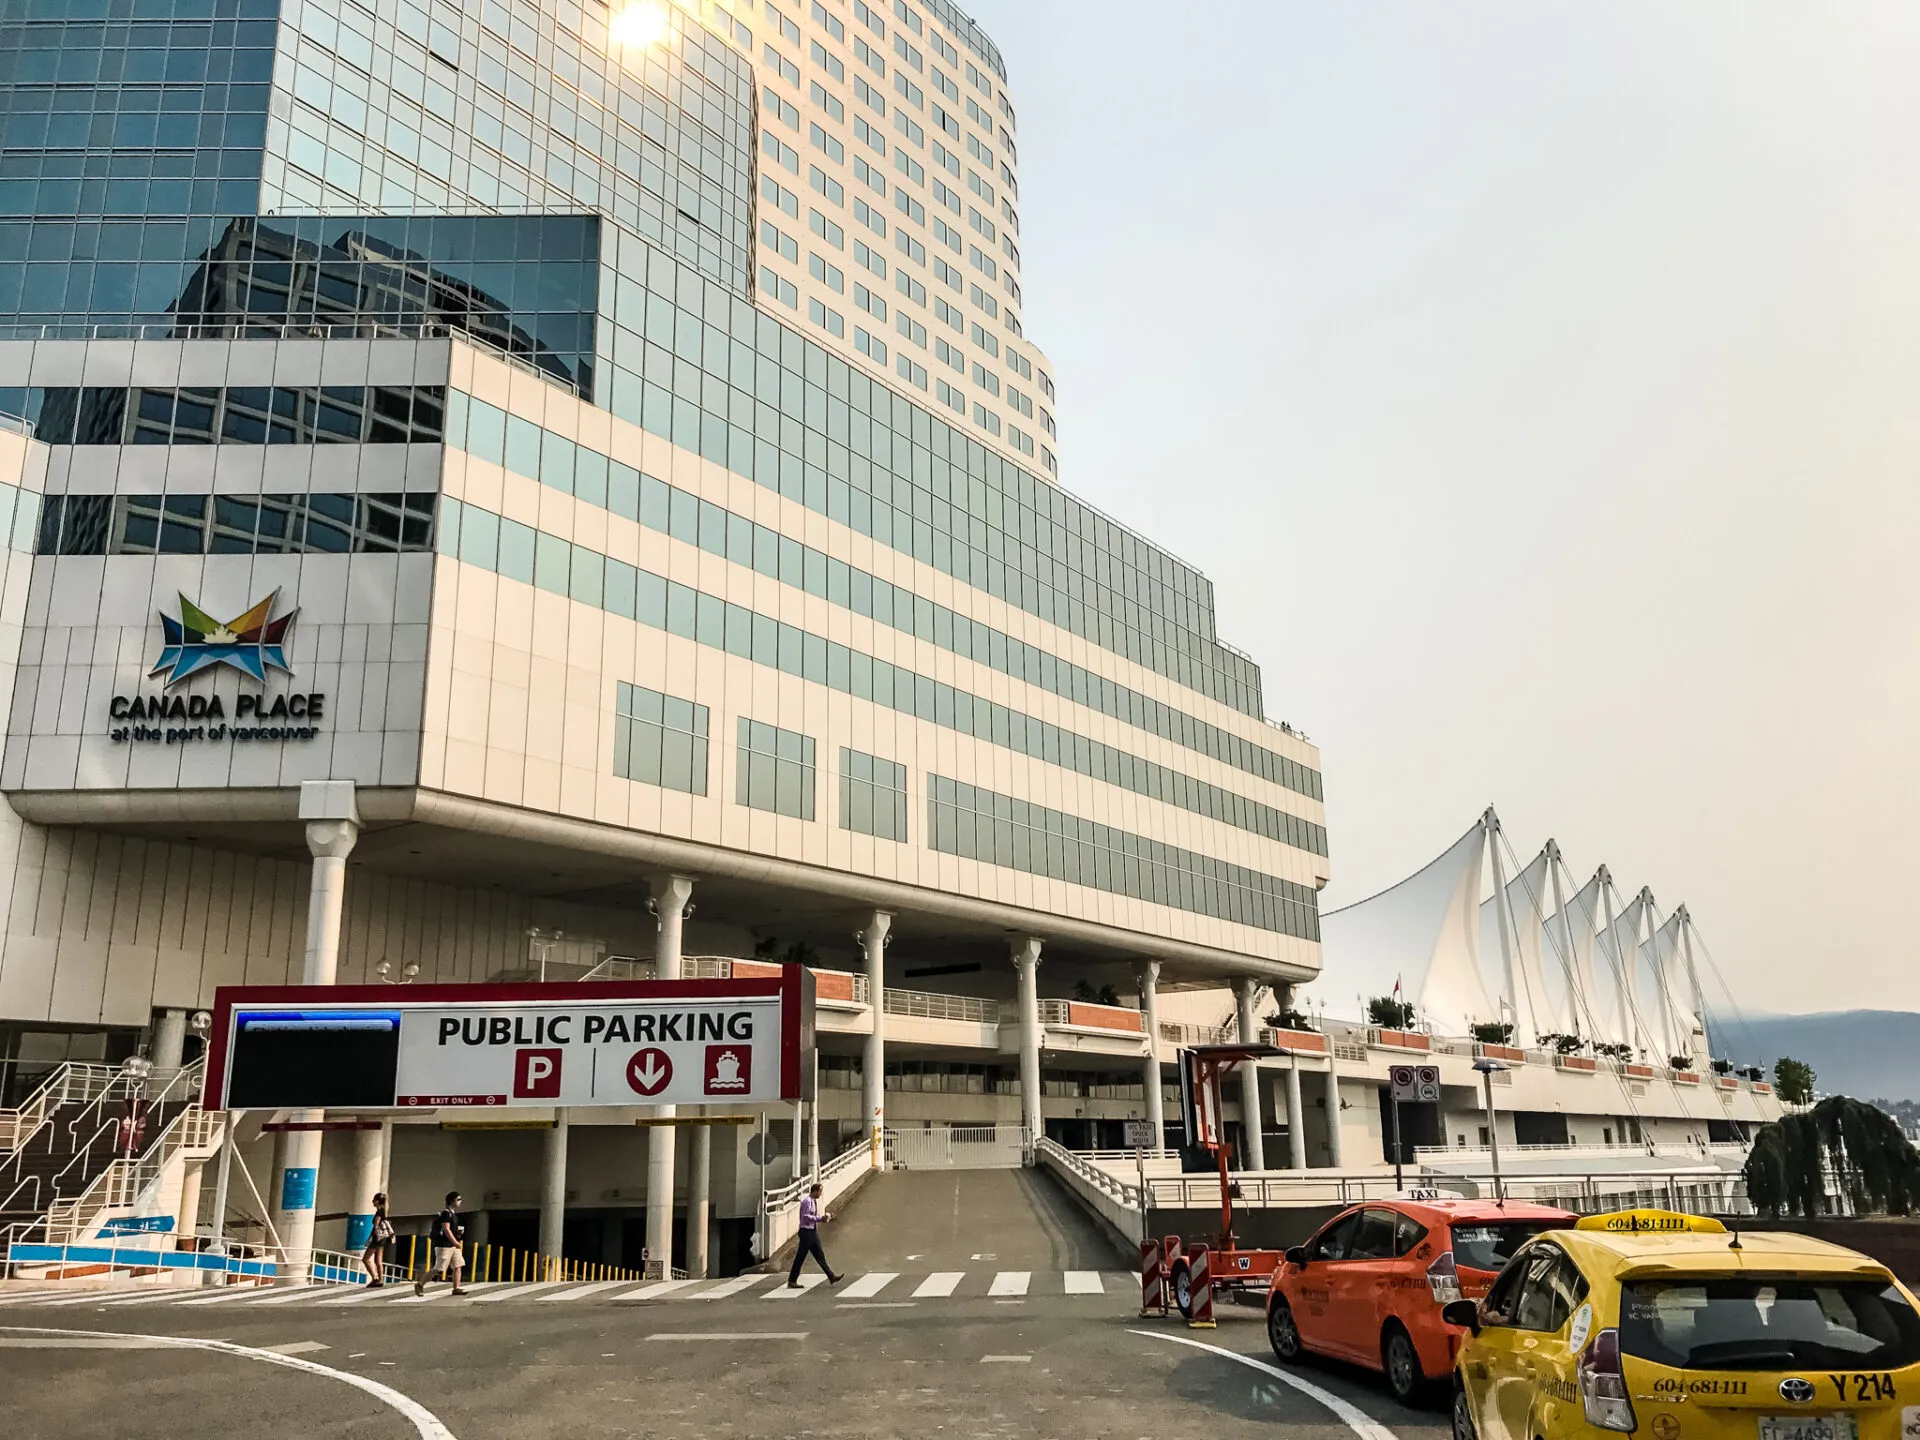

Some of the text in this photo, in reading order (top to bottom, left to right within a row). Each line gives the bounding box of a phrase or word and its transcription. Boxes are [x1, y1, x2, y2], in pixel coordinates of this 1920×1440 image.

[110, 693, 325, 719] CANADA PLACE
[111, 723, 319, 744] at the port of vancouver
[438, 1011, 753, 1046] PUBLIC PARKING
[526, 1056, 553, 1090] P
[430, 1097, 448, 1105] EXIT
[1408, 1189, 1439, 1199] TAXI
[1238, 1258, 1250, 1269] W
[1829, 1373, 1896, 1402] Y 214
